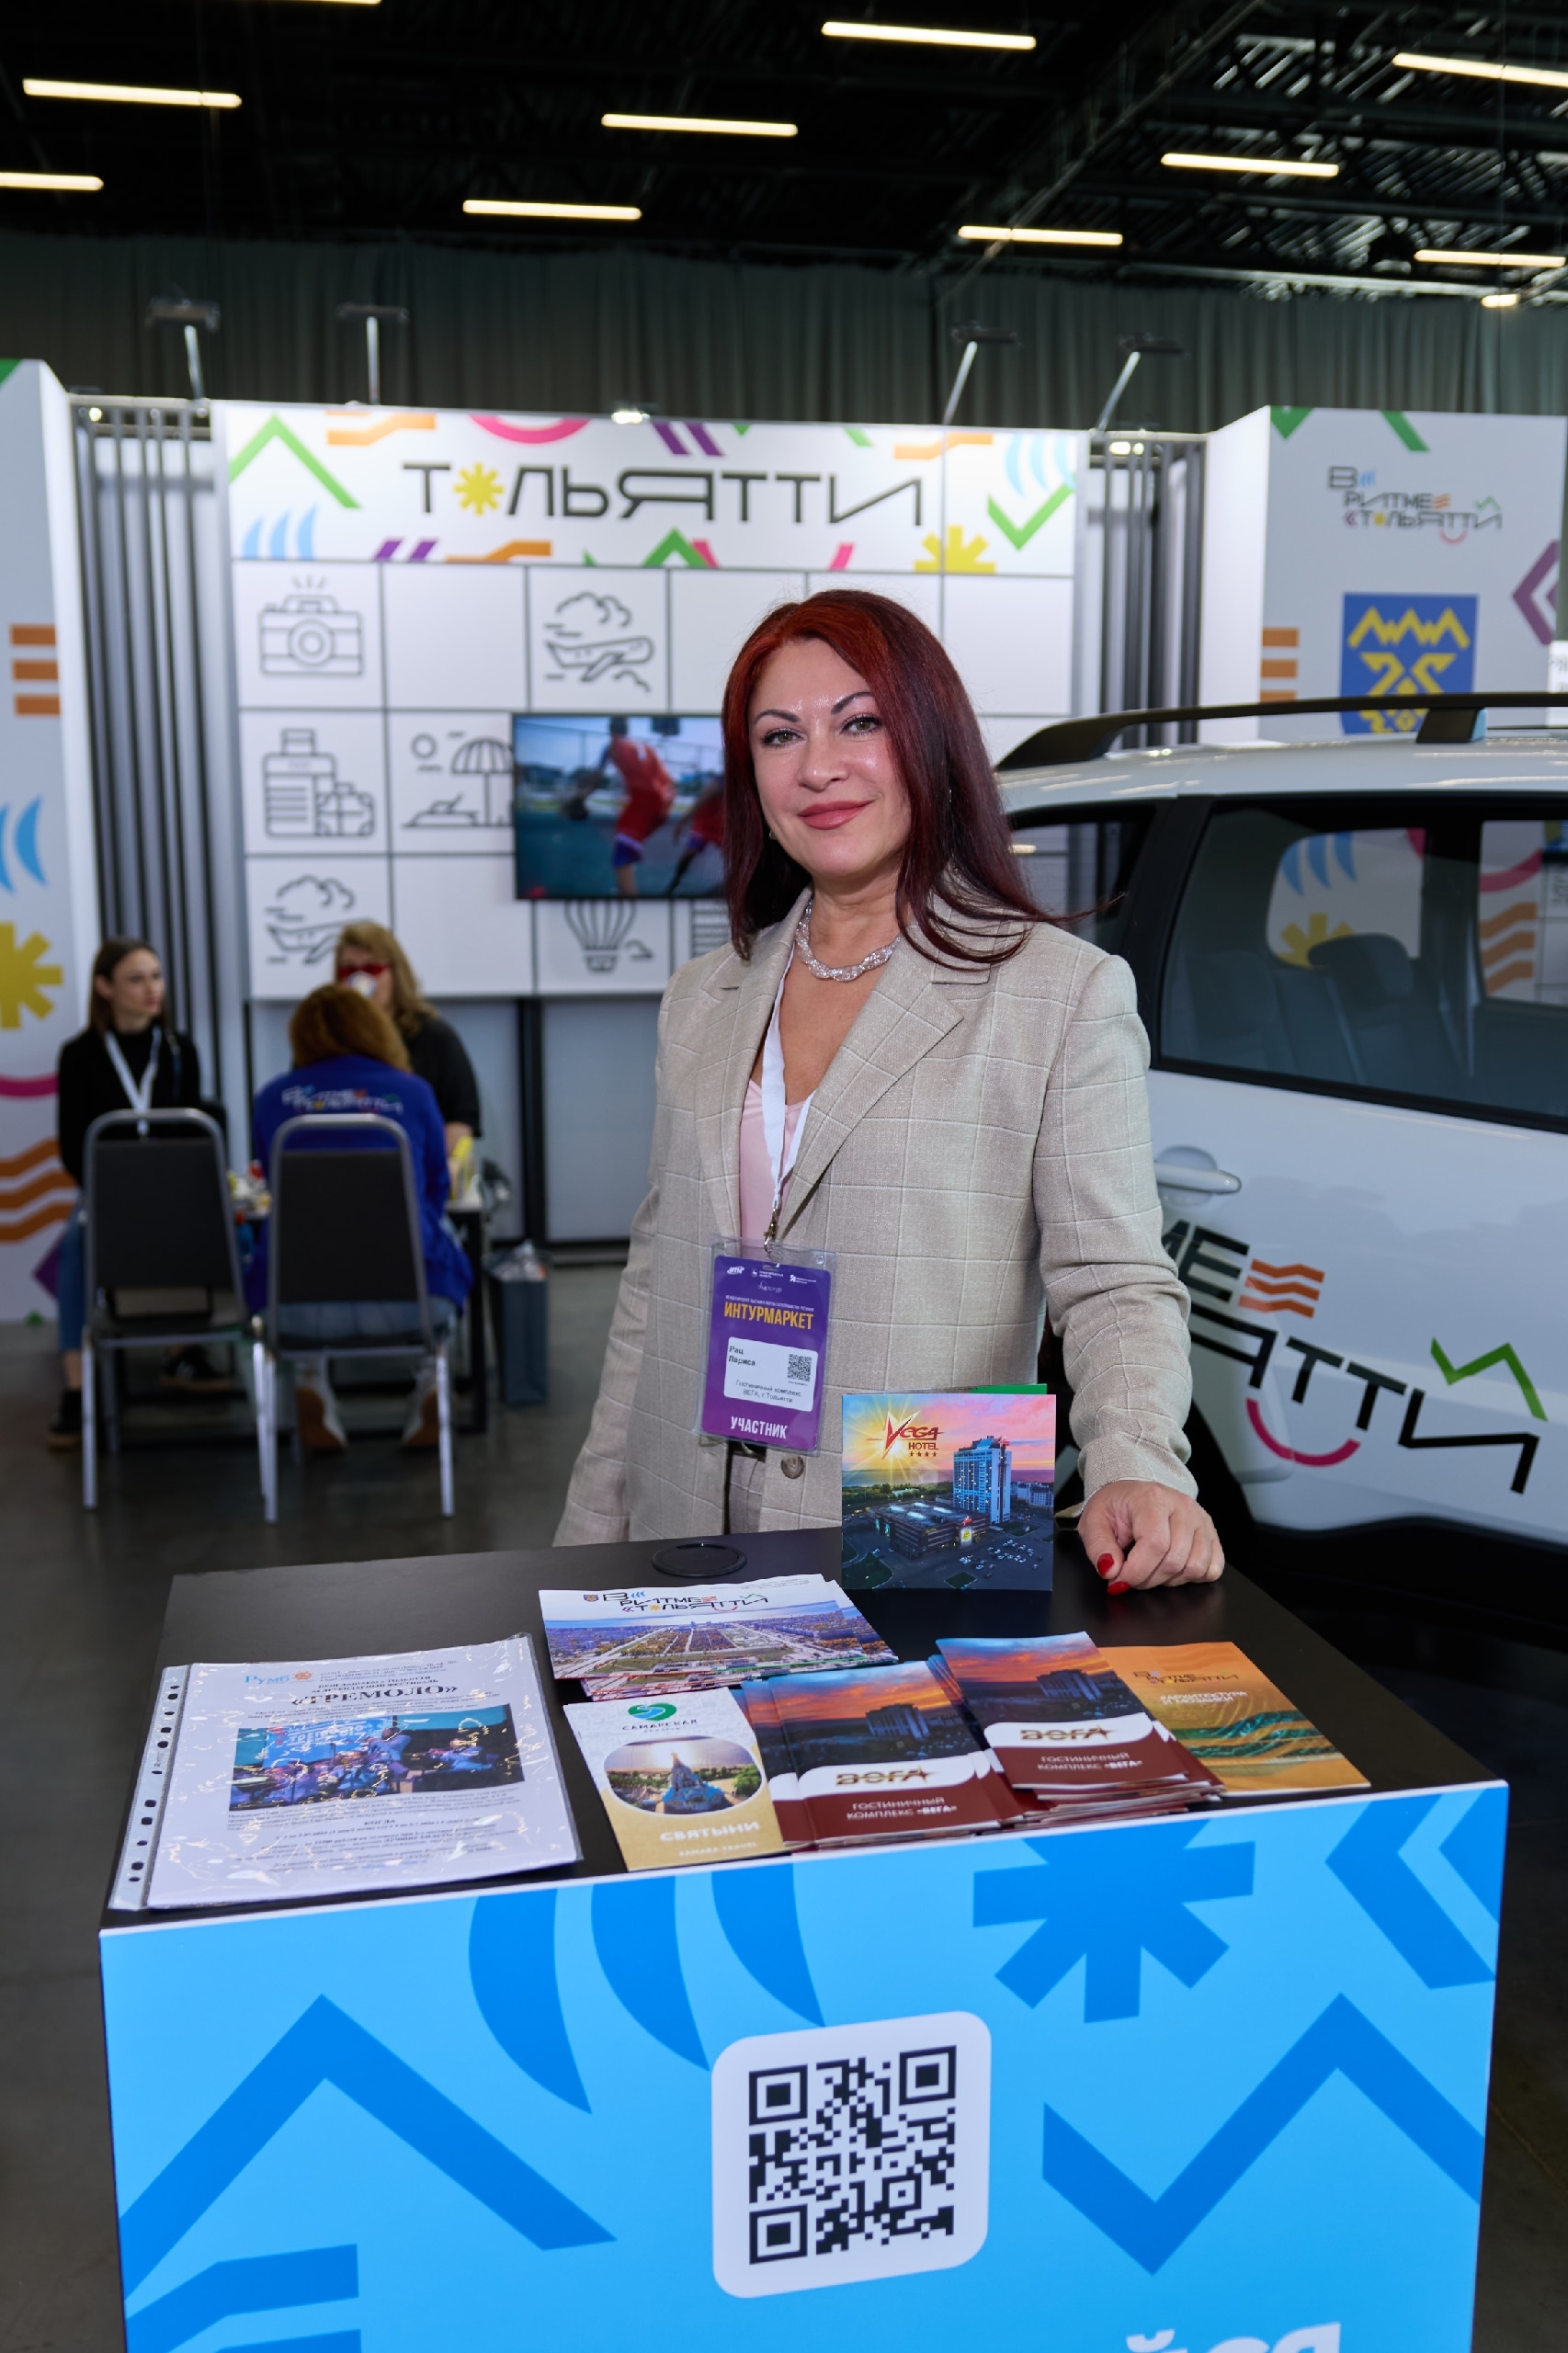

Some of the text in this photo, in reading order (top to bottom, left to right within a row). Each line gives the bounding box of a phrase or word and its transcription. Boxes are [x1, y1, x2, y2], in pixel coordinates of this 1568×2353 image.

[1329, 466, 1358, 489] В
[1345, 491, 1433, 509] РИТМЕ
[724, 1302, 813, 1329] ИНТУРМАРКЕТ
[729, 1346, 744, 1355] Рац
[728, 1356, 756, 1366] Лариса
[731, 1415, 788, 1438] УЧАСТНИК
[603, 1592, 629, 1601] В
[619, 1597, 702, 1607] РИТМЕ
[622, 1720, 697, 1730] САМАРСКАЯ
[852, 1797, 945, 1811] ГОСТИНИЧНЫЙ
[846, 1809, 915, 1820] КОМПЛЕКС
[660, 1821, 761, 1842] СВЯТЫНИ
